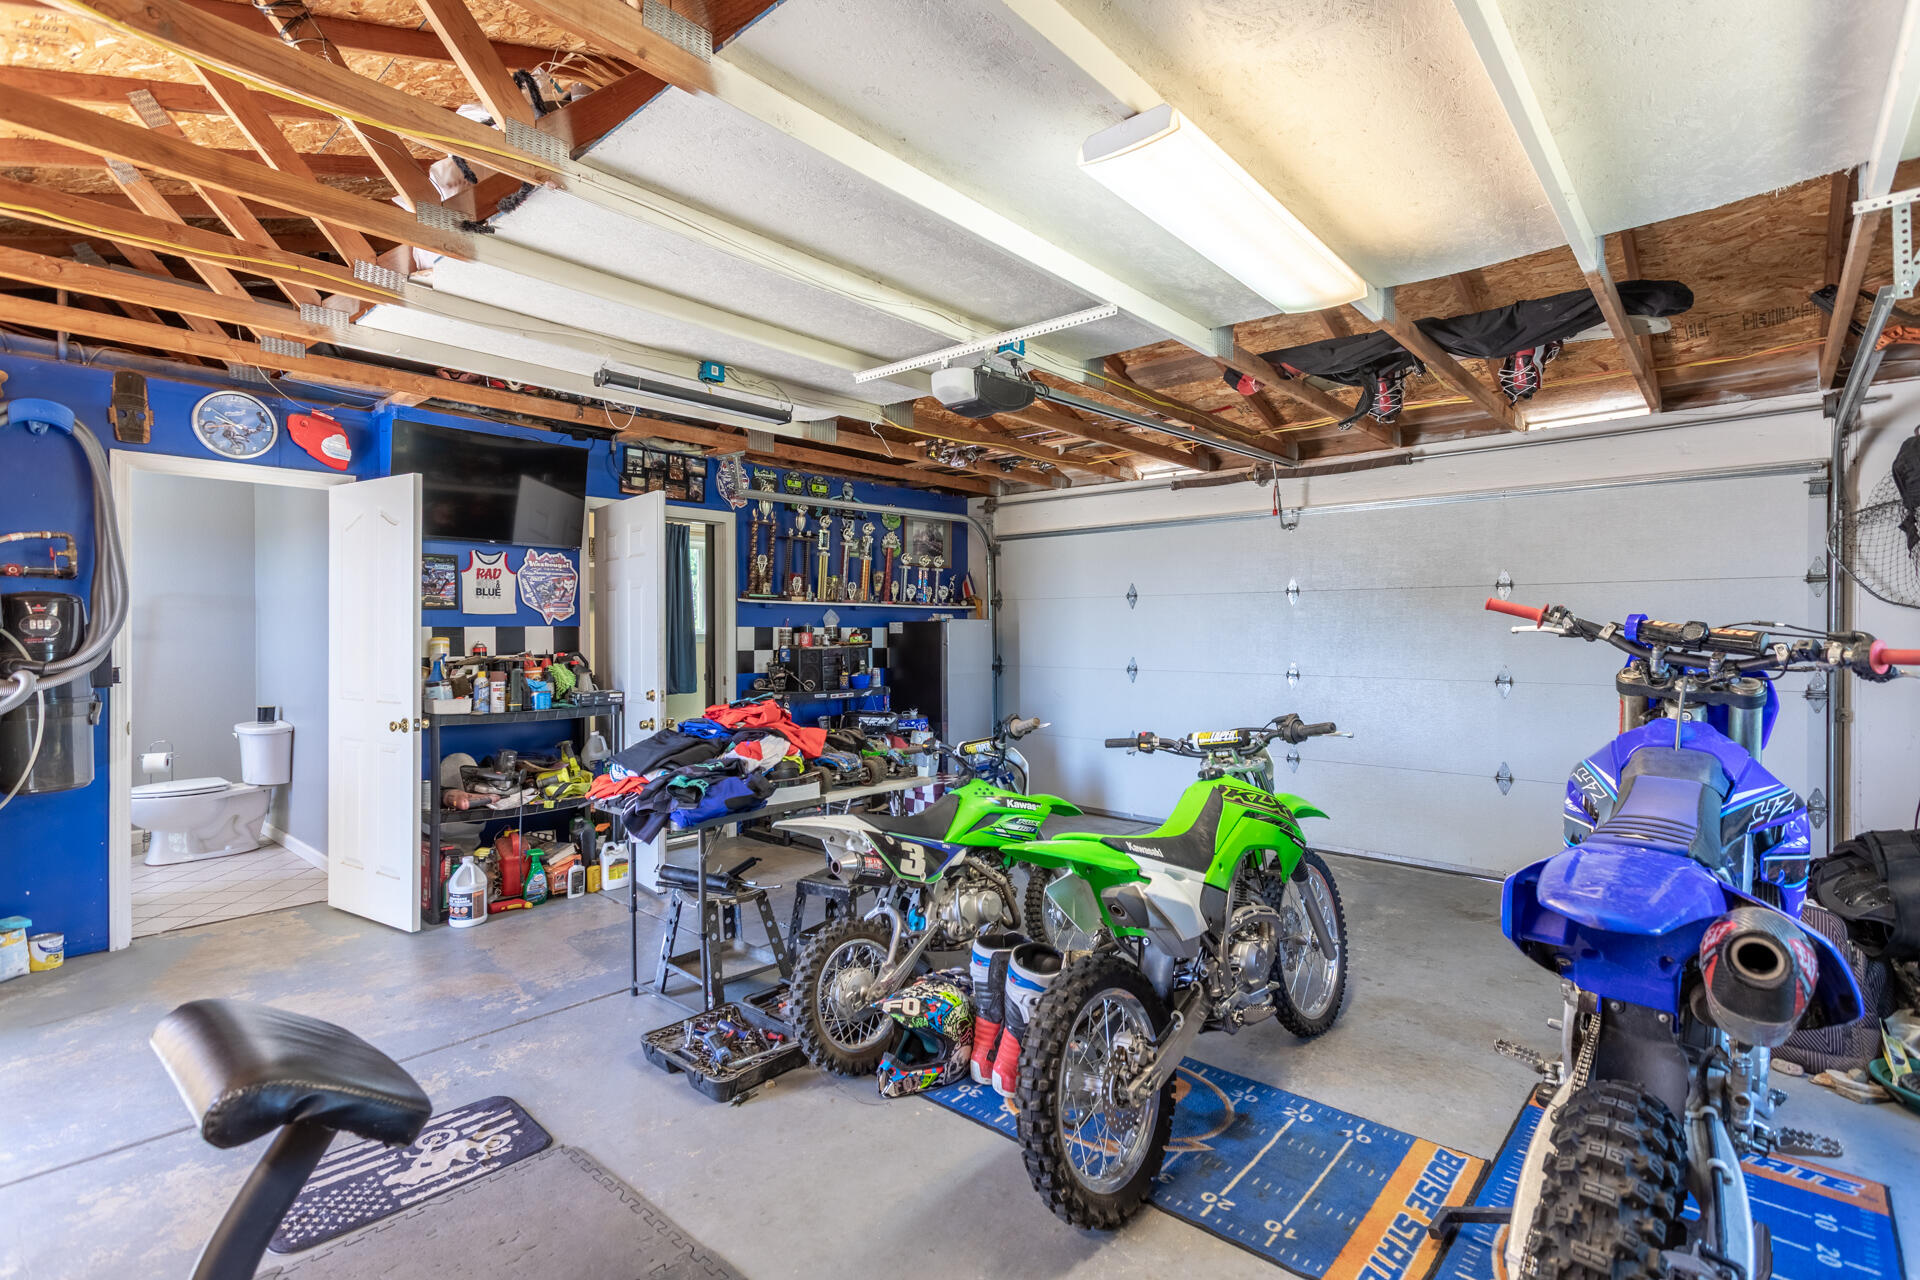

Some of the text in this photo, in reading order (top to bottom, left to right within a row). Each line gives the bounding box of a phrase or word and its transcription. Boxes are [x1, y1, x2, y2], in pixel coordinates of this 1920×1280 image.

[476, 568, 502, 580] RAD
[475, 587, 502, 597] BLUE
[1006, 798, 1043, 811] Kawas
[1222, 786, 1292, 820] KLX
[1125, 840, 1165, 858] Kawasaki
[900, 841, 926, 877] 3
[1231, 1089, 1258, 1103] 30
[1281, 1106, 1314, 1123] 20
[1341, 1128, 1372, 1144] 10
[1402, 1145, 1470, 1222] BOISE
[1201, 1191, 1236, 1211] 20
[1264, 1219, 1297, 1240] 10
[1815, 1212, 1838, 1232] 10
[1816, 1242, 1842, 1269] 20
